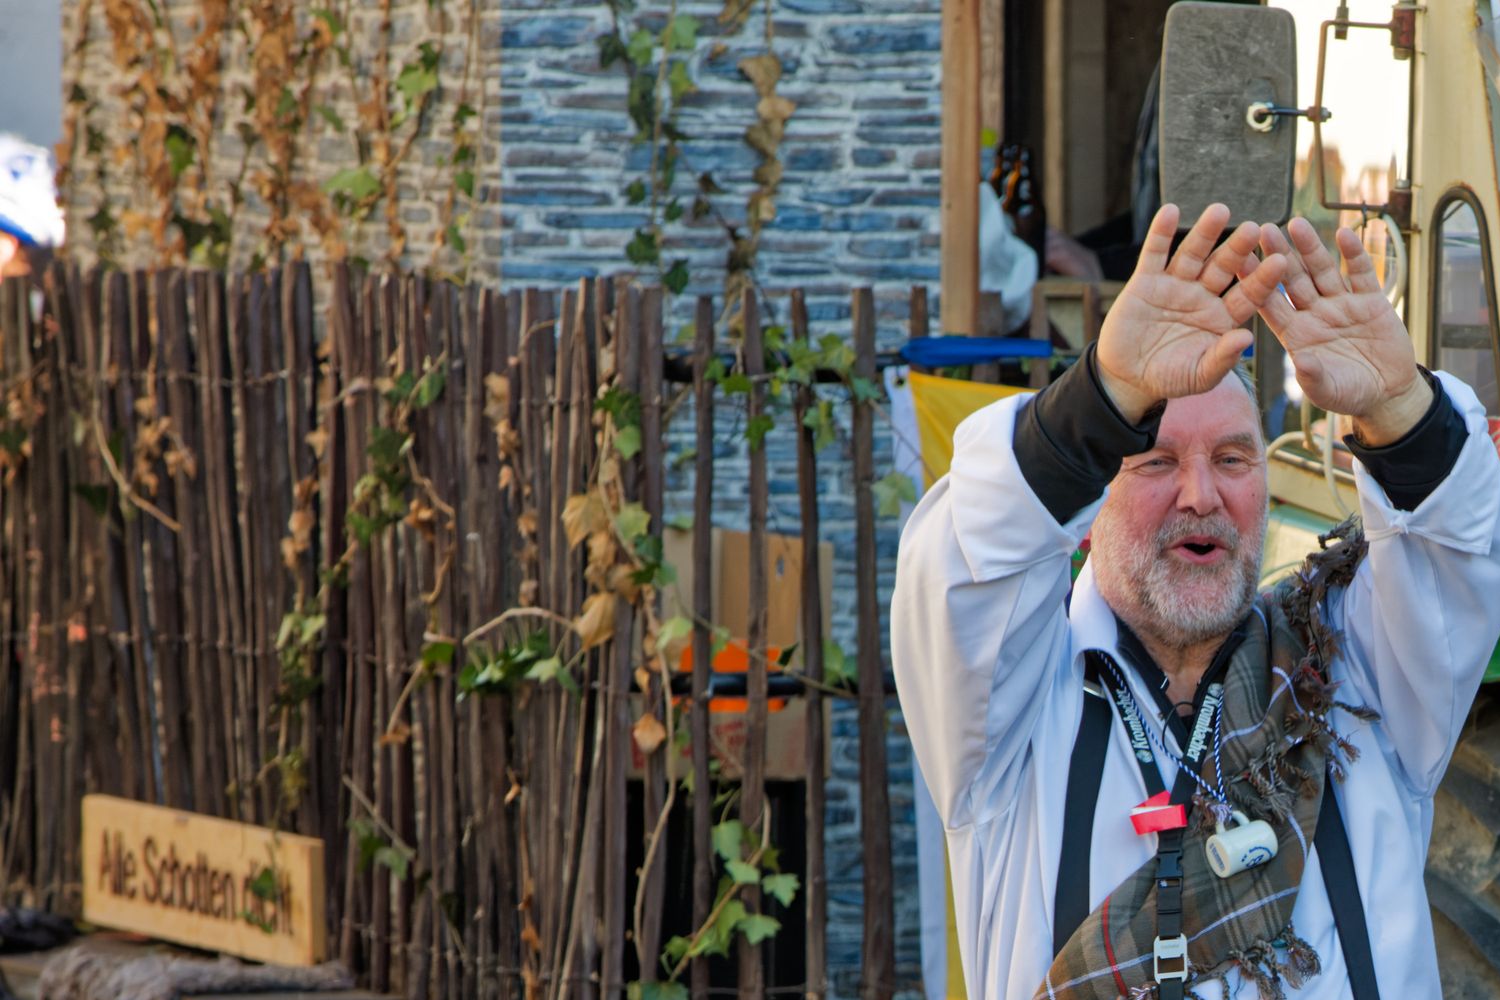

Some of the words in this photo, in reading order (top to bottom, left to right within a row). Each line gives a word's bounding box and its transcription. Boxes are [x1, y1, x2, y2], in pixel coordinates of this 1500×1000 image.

[1187, 694, 1219, 762] Krombacher
[100, 827, 137, 899] Alle
[142, 835, 237, 921] Schotten
